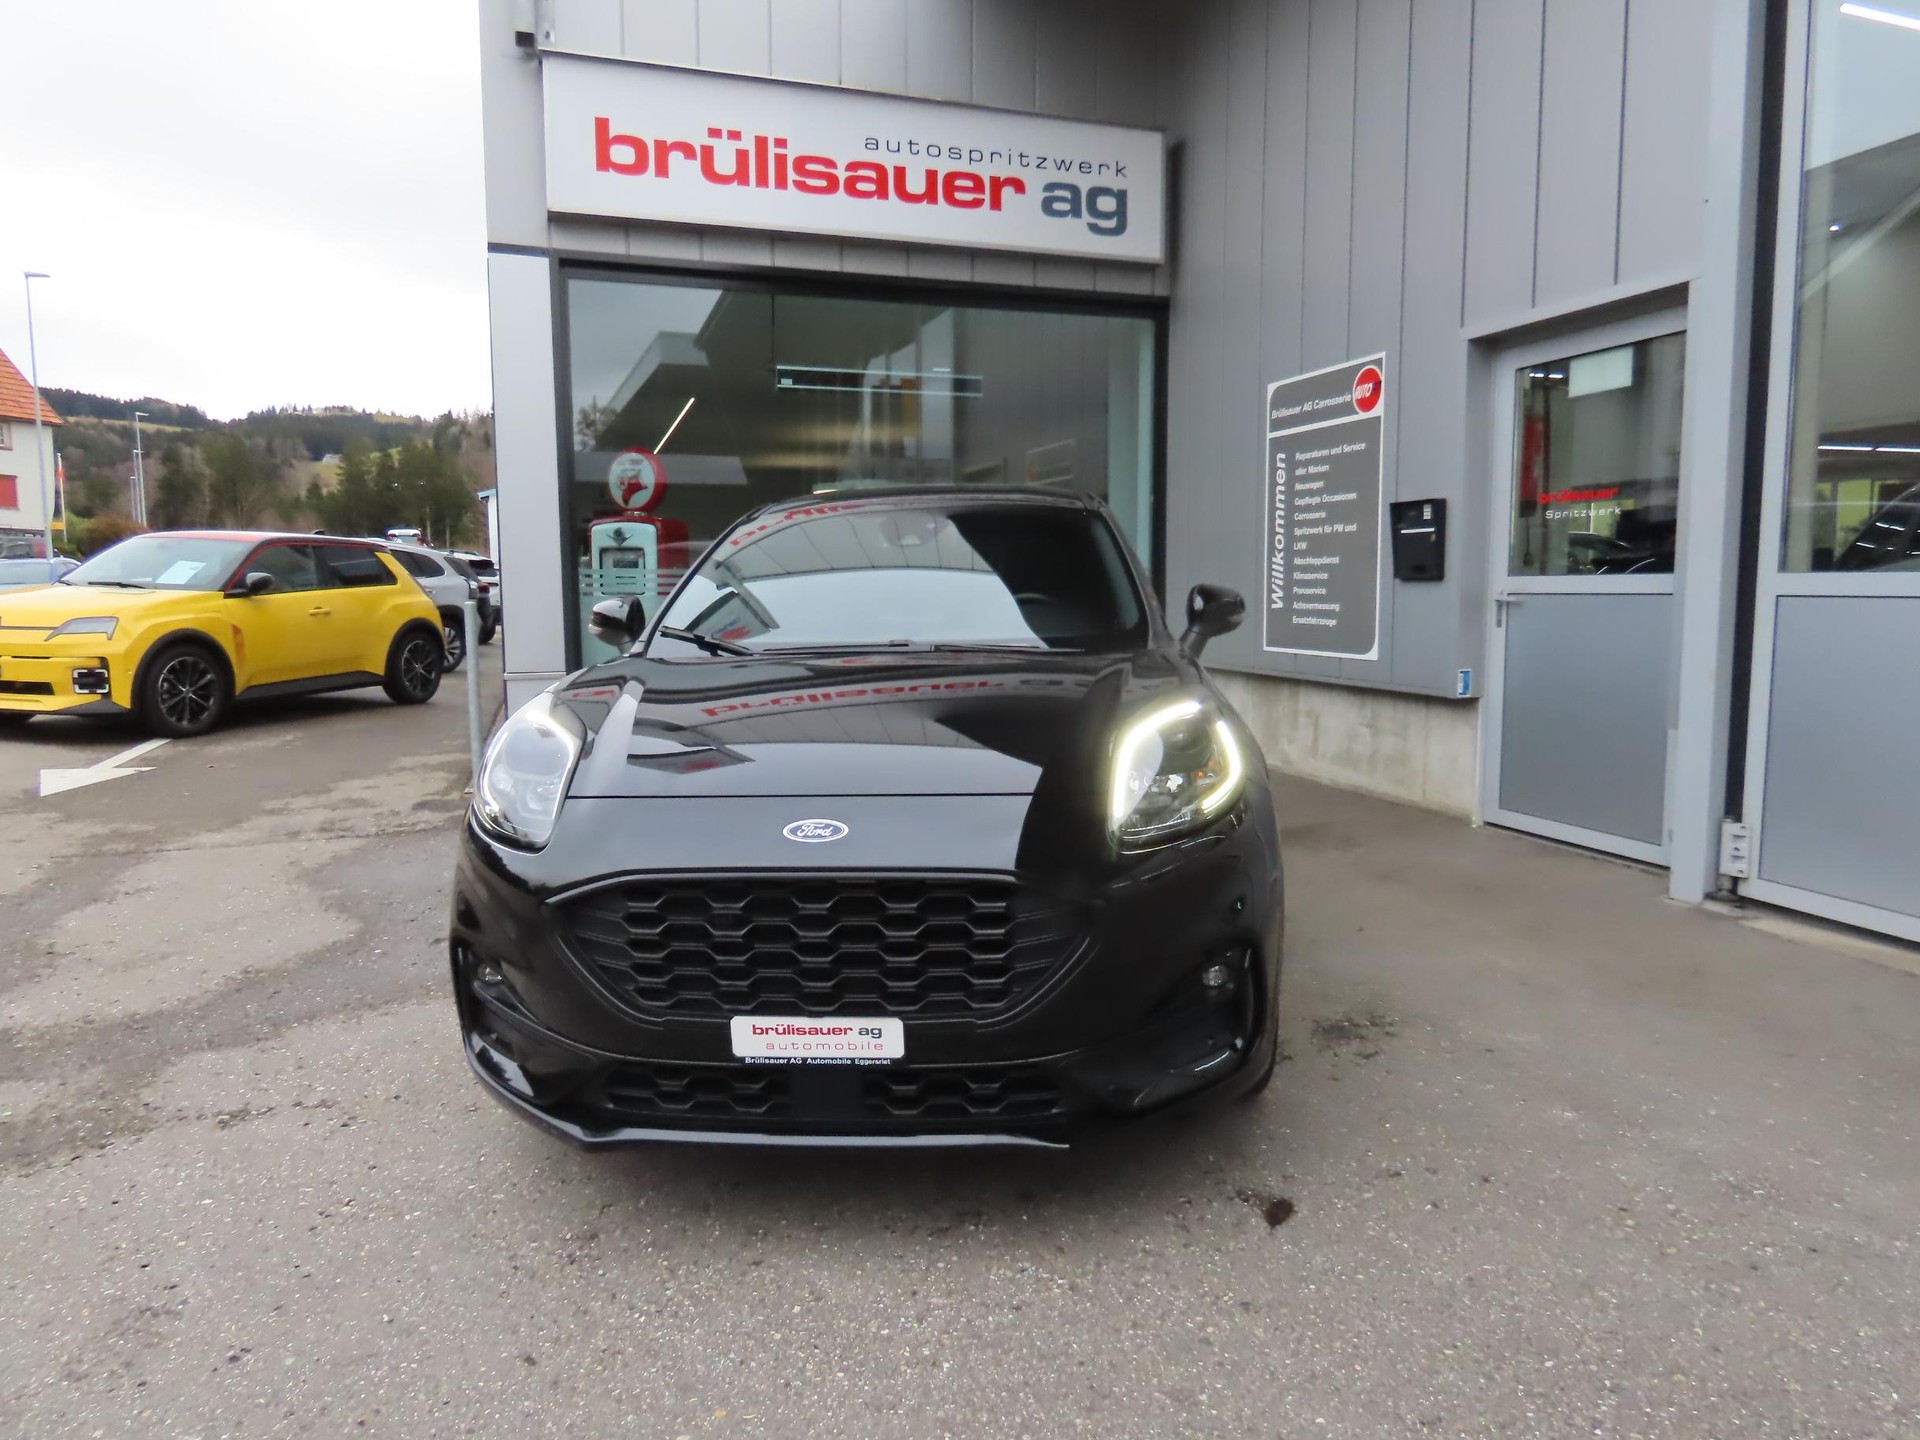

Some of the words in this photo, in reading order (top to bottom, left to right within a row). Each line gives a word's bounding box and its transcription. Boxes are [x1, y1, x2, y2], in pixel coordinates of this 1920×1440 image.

[864, 136, 1128, 179] autospritzwerk
[594, 117, 1026, 212] brülisauer
[1041, 181, 1128, 237] ag
[1302, 400, 1313, 412] AG
[1313, 392, 1352, 409] Carrosserie
[1295, 449, 1330, 461] Reparaturen
[1330, 445, 1342, 455] und
[1342, 442, 1366, 453] Service
[1307, 465, 1330, 474] Marken
[1294, 481, 1324, 491] Neuwagen
[1294, 496, 1321, 507] Gepflegte
[1321, 493, 1357, 503] Occasionen
[1294, 511, 1326, 520] Carrosserie
[1545, 506, 1622, 519] Spritzwerk
[1271, 452, 1286, 609] Willkommen
[1293, 525, 1323, 536] Spritzwerk
[1323, 524, 1332, 533] für
[1333, 523, 1344, 533] PW
[1344, 522, 1357, 532] und
[1293, 541, 1307, 550] LKW
[1293, 555, 1339, 566] Abschleppdienst
[1293, 571, 1328, 580] Klimaservice
[1292, 586, 1326, 595] Pneuservice
[1292, 615, 1337, 627] Ersatzfahrzeuge
[797, 823, 833, 836] Ford
[752, 1024, 854, 1036] brülisauer
[858, 1027, 883, 1039] ag
[765, 1041, 884, 1051] automobile
